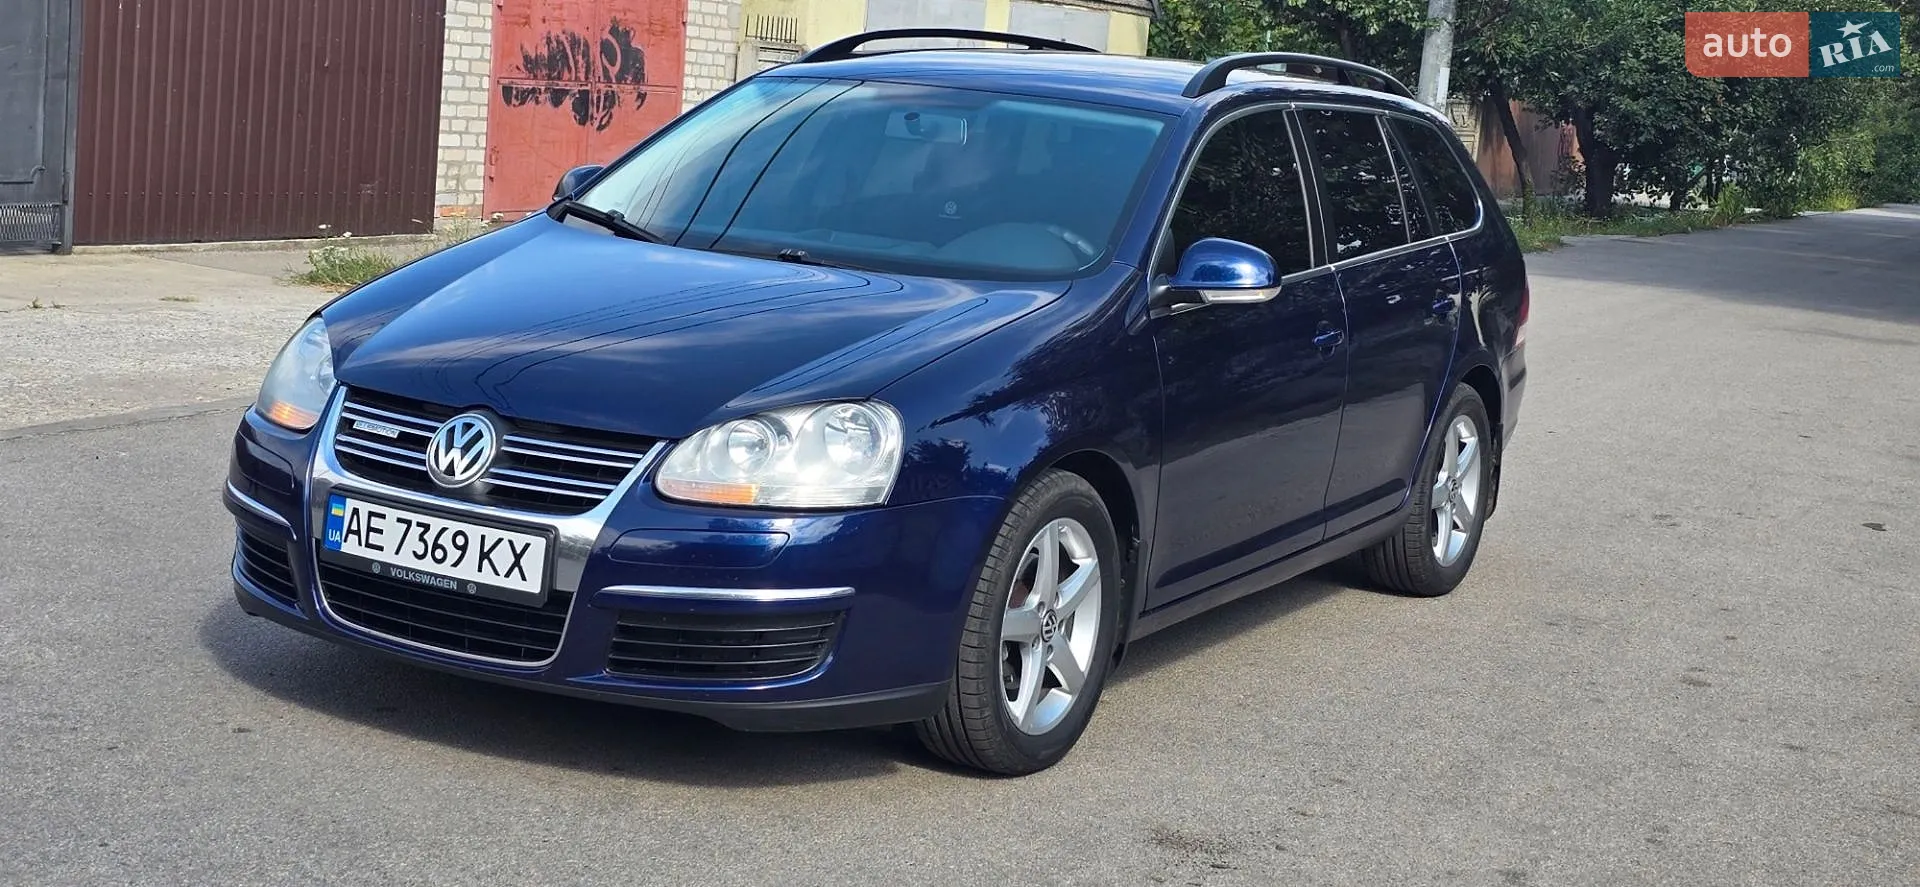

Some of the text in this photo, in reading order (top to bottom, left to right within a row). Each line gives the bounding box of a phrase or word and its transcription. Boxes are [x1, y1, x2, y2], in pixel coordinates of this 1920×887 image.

[328, 529, 341, 543] UA
[344, 507, 531, 582] AE 7369 KX
[390, 567, 457, 590] VOLKSWAGEN
